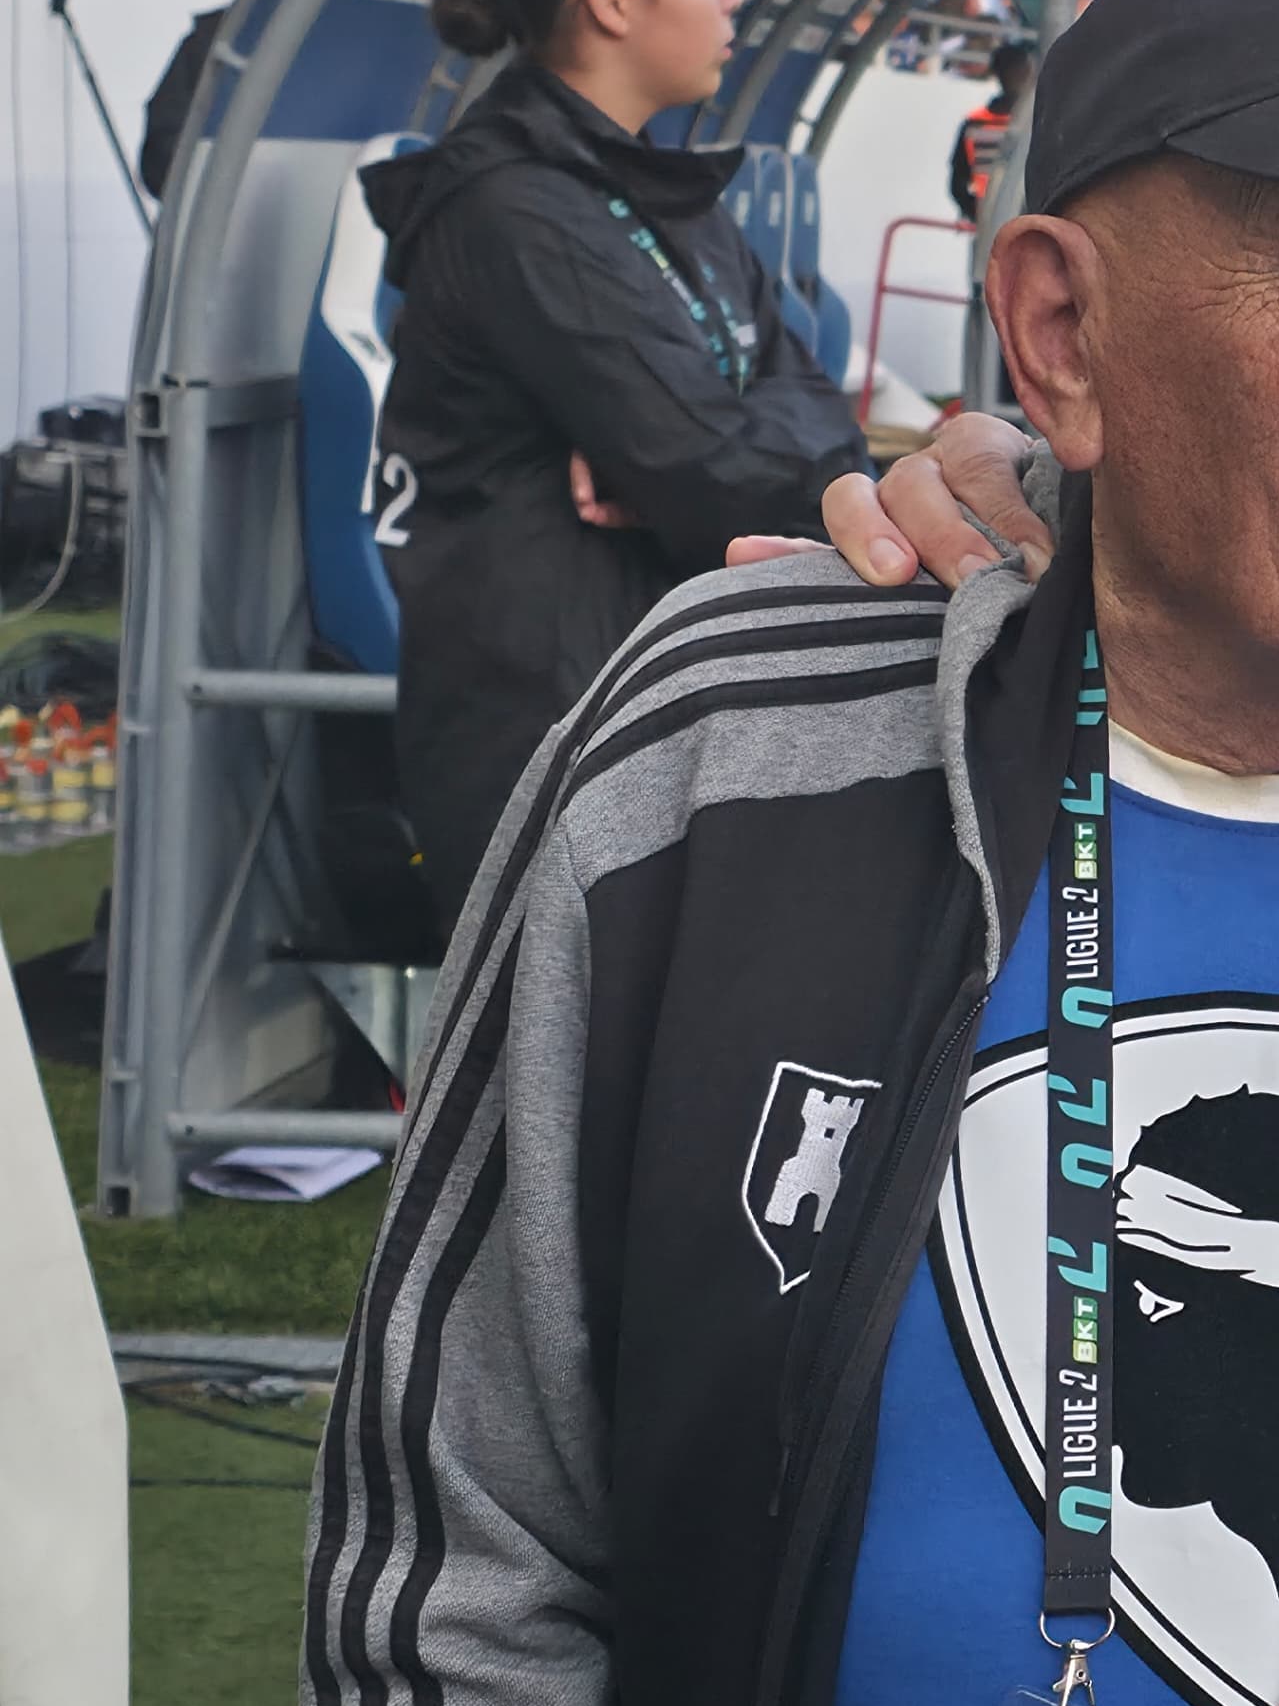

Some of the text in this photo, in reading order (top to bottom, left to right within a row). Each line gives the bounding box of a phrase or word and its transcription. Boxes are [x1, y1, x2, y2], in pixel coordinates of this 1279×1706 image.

[1074, 822, 1098, 880] BKT
[1066, 907, 1098, 980] LIGUE
[1073, 1296, 1098, 1364] BKT
[1062, 1396, 1098, 1479] LIGUE
